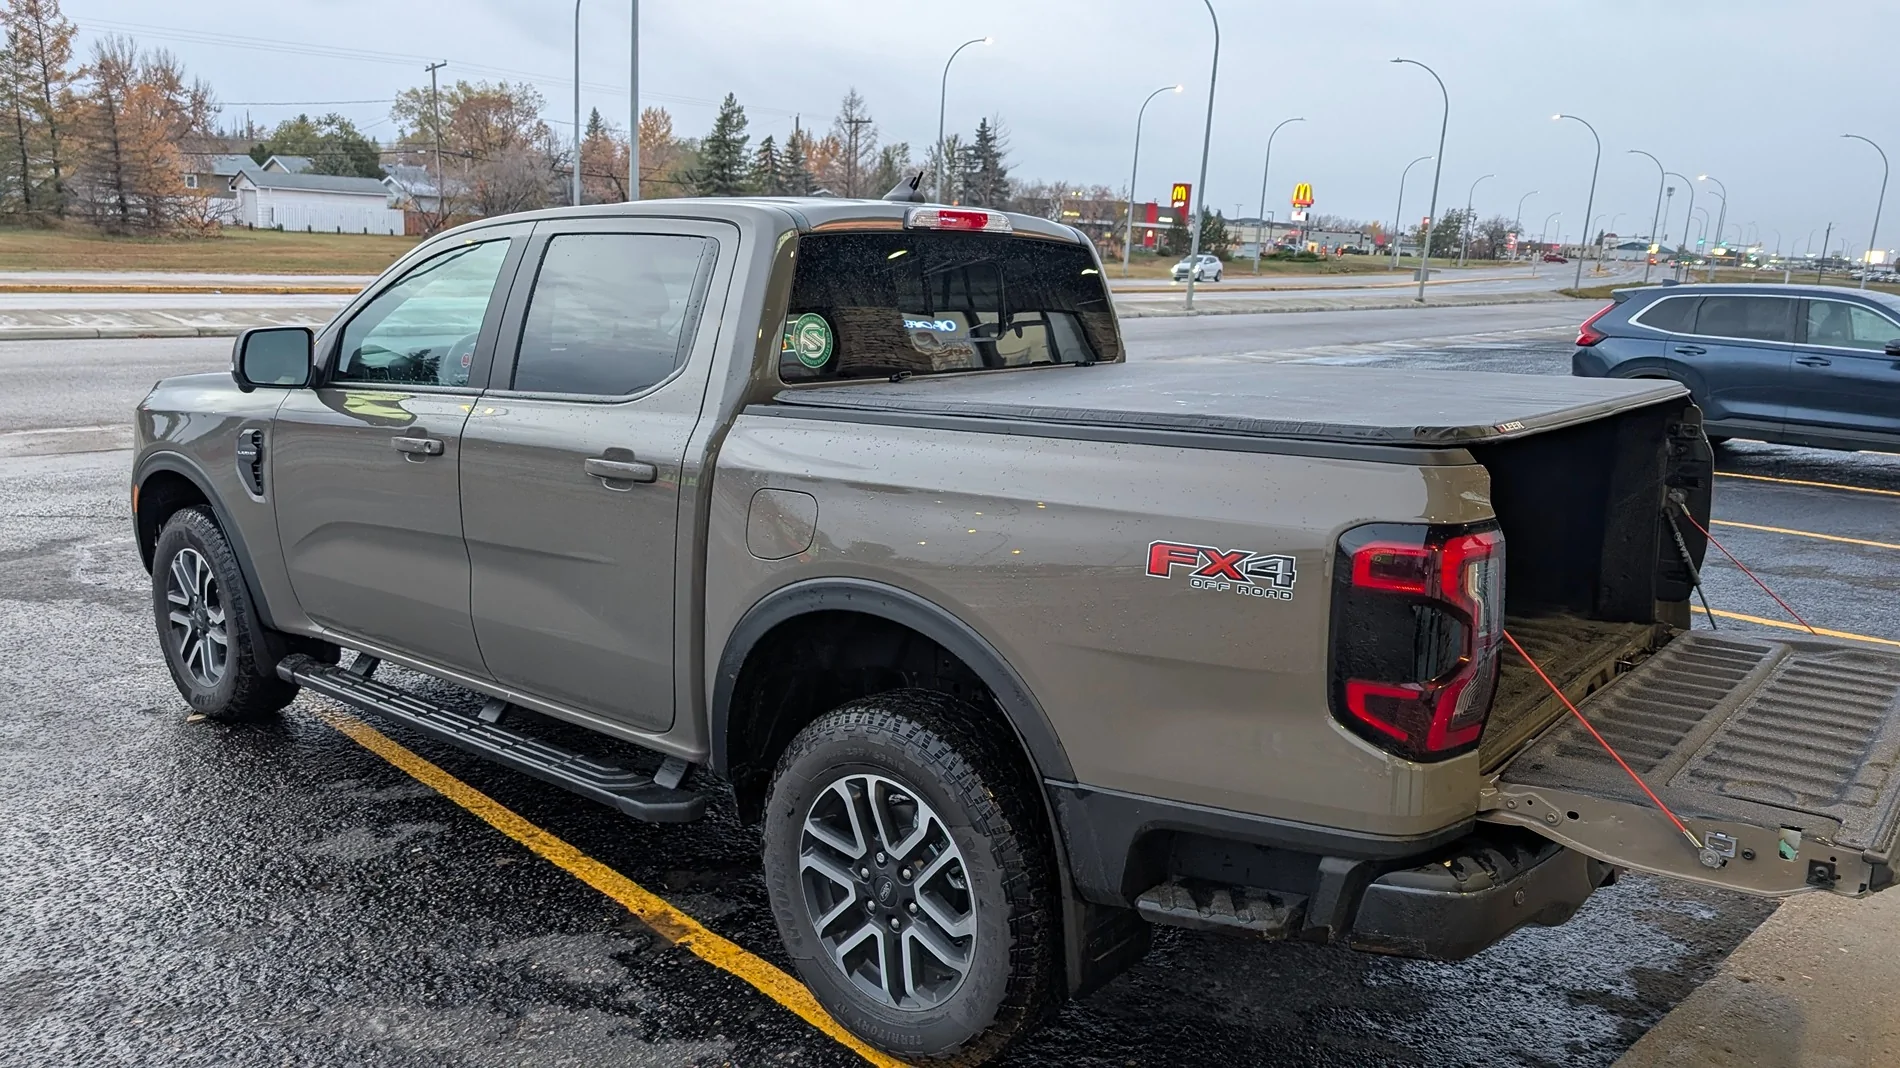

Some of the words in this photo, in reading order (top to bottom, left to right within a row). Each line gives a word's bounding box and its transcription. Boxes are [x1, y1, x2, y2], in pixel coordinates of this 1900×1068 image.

[1502, 420, 1525, 431] LEER
[1146, 540, 1297, 589] FX4
[1190, 578, 1230, 591] OFF
[1236, 584, 1293, 600] ROAD
[852, 1017, 924, 1046] TERRITORY
